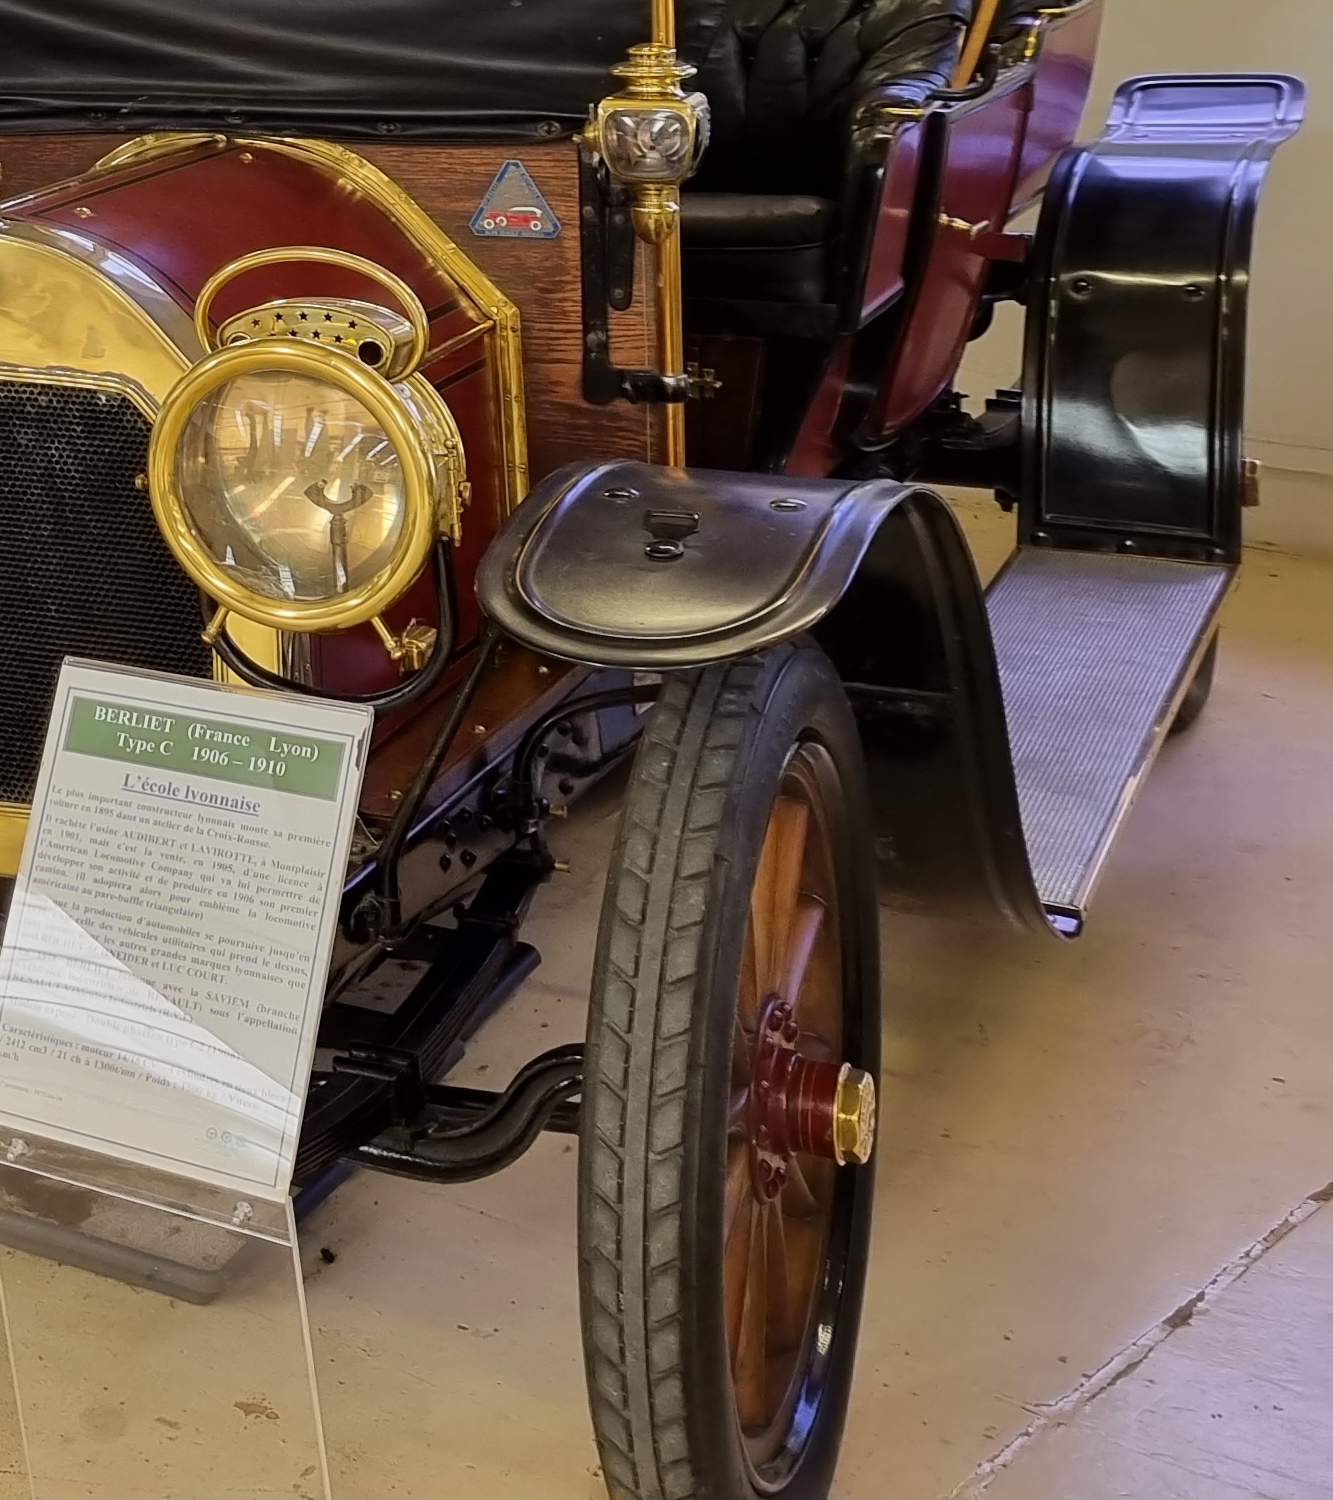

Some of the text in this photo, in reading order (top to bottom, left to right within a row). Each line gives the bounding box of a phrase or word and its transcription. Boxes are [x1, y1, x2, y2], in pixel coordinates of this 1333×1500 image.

[94, 705, 318, 761] BERLIET (France Lyon)
[116, 731, 155, 753] Type
[159, 740, 173, 755] C
[192, 746, 229, 765] 1906
[248, 756, 285, 776] 1910
[123, 772, 260, 812] L'école lyonnaise
[45, 813, 52, 822] Il
[54, 817, 86, 829] rachète
[89, 822, 118, 836] l'usine
[122, 829, 176, 847] AUDIBERT
[179, 842, 187, 850] et
[49, 798, 78, 809] voiture
[80, 804, 91, 812] en
[94, 805, 114, 817] 1895
[115, 810, 136, 821] dans
[138, 816, 150, 824] un
[152, 819, 181, 830] atelier
[182, 824, 193, 833] de
[195, 825, 204, 835] la
[51, 784, 62, 794] Le
[65, 788, 84, 798] plus
[197, 812, 235, 828] lyonnais
[240, 823, 268, 835] monte
[287, 832, 331, 847] première
[42, 827, 52, 835] en
[60, 829, 82, 842] 1901,
[89, 837, 109, 847] mais
[116, 842, 137, 852] c'est
[143, 846, 152, 856] la
[160, 851, 186, 864] vente,
[212, 860, 235, 874] 1905,
[242, 867, 270, 880] d'une
[277, 874, 309, 888] licence
[34, 864, 68, 877] camion.
[75, 871, 85, 881] (il
[92, 876, 131, 890] adoptera
[139, 886, 161, 897] alors
[168, 893, 191, 903] pour
[198, 900, 240, 914] emblème
[247, 907, 256, 918] la
[81, 887, 92, 895] au
[88, 863, 103, 871] son
[107, 867, 140, 879] activité
[157, 875, 168, 885] de
[172, 880, 212, 895] produire
[216, 890, 227, 898] en
[233, 891, 254, 903] 1906
[259, 899, 275, 908] son
[279, 903, 318, 917] premier
[150, 860, 193, 879] Company
[199, 873, 214, 882] qui
[220, 877, 231, 885] va
[237, 878, 250, 889] lui
[308, 894, 320, 904] de
[71, 901, 79, 910] la
[267, 945, 309, 962] jusqu'en
[98, 921, 113, 931] des
[209, 948, 225, 956] qui
[228, 952, 257, 964] prend
[261, 957, 270, 967] le
[274, 960, 307, 976] dessus,
[103, 935, 116, 945] les
[118, 940, 146, 952] autres
[150, 947, 186, 961] grandes
[190, 956, 230, 971] marques
[287, 979, 305, 989] que
[161, 961, 184, 973] LUC
[186, 967, 228, 984] COURT.
[162, 983, 299, 1020] avec la SAVIEM (branche
[209, 1007, 229, 1018] sous
[5, 1036, 25, 1049] 2412
[28, 1044, 47, 1054] cm3
[56, 1049, 67, 1060] 21
[69, 1054, 81, 1063] ch
[144, 1072, 170, 1087] Poids
[80, 1044, 114, 1058] moteur
